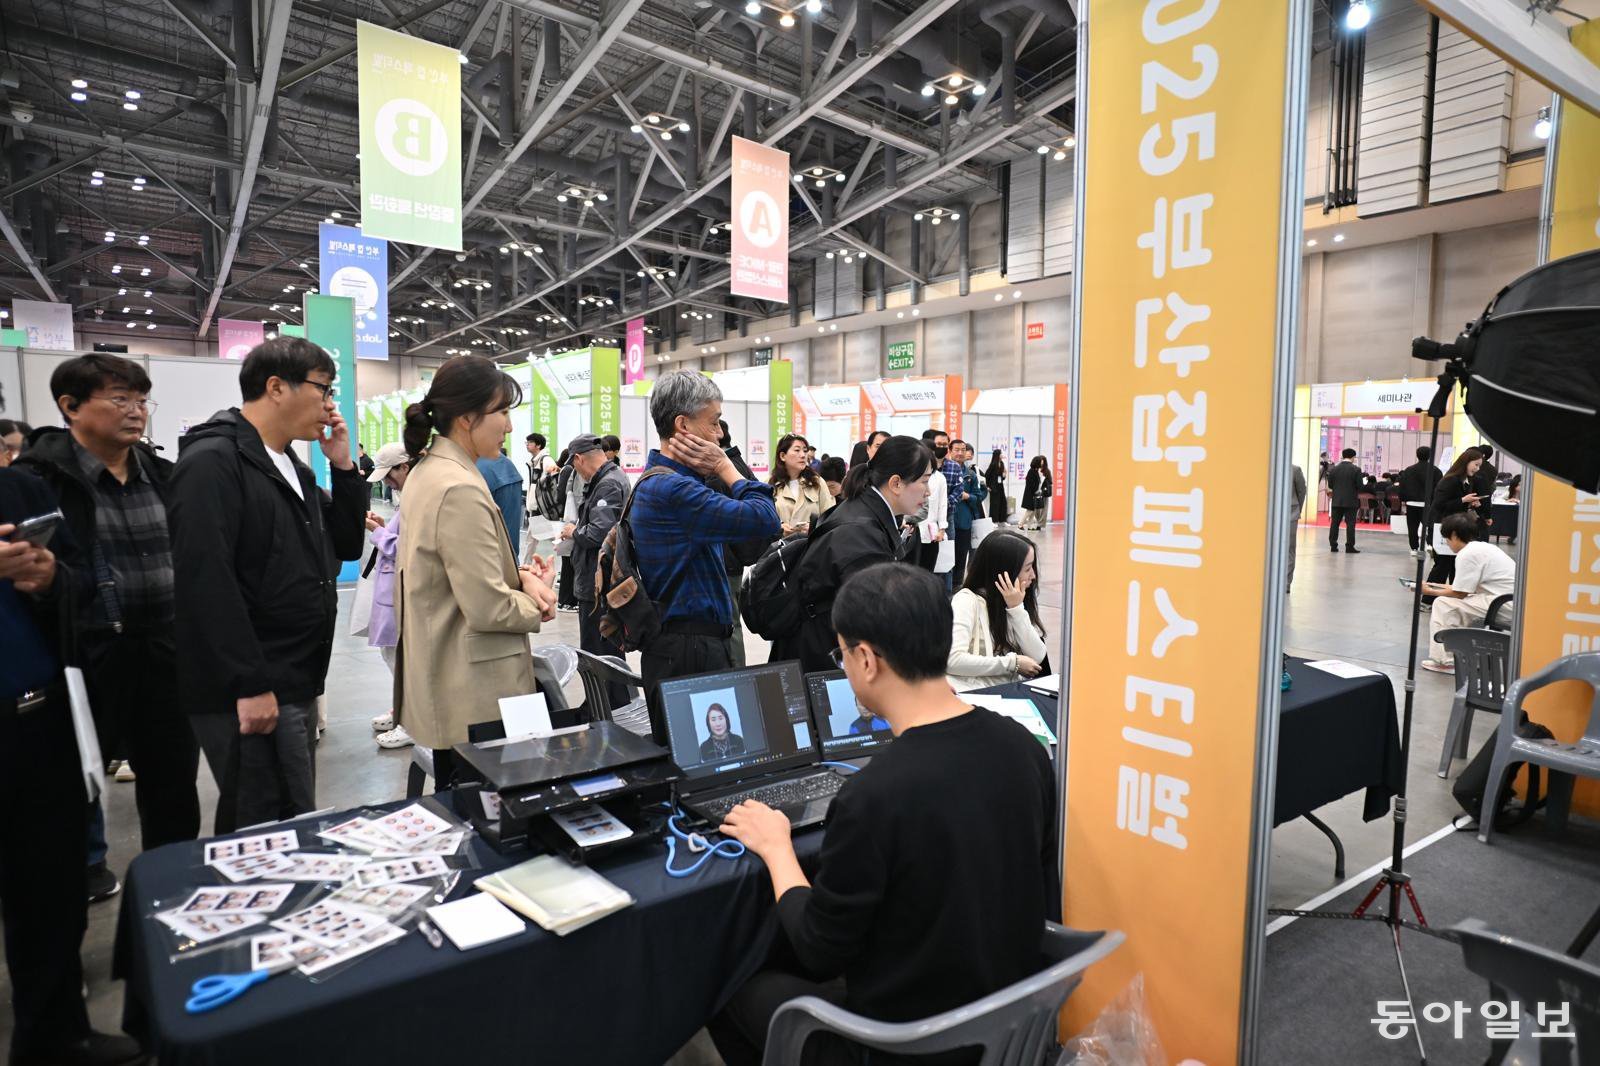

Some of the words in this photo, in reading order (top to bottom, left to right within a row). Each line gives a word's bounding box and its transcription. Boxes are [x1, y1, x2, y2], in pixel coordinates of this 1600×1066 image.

[893, 358, 909, 368] EXIT
[539, 394, 550, 422] 2025
[600, 386, 612, 420] 2025
[777, 394, 786, 424] 2025
[1377, 393, 1412, 403] 세미나관
[864, 408, 872, 432] 2025
